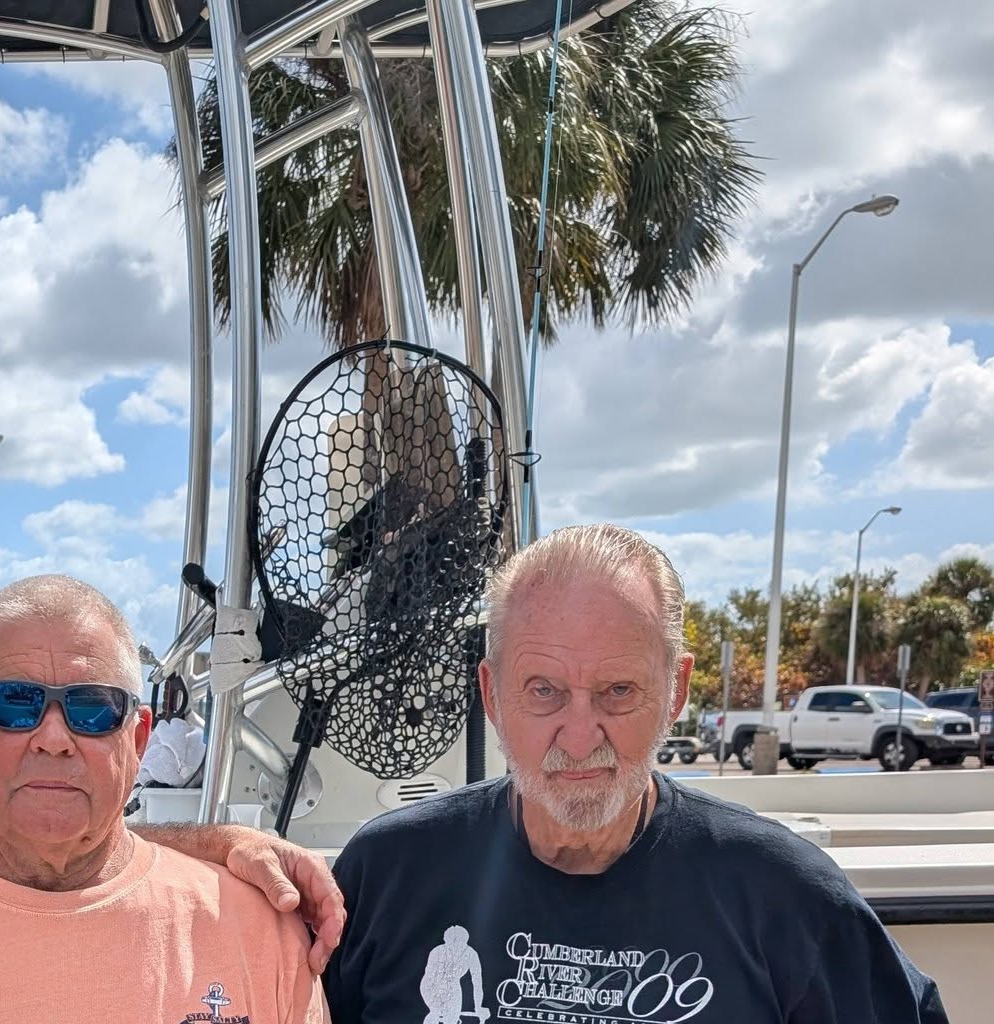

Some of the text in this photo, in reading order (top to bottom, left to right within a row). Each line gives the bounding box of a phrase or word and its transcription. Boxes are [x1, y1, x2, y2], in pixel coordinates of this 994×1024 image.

[506, 932, 646, 968] CUMBERLAND
[517, 957, 583, 984] RIVER
[496, 978, 624, 1007] CHALLENGE
